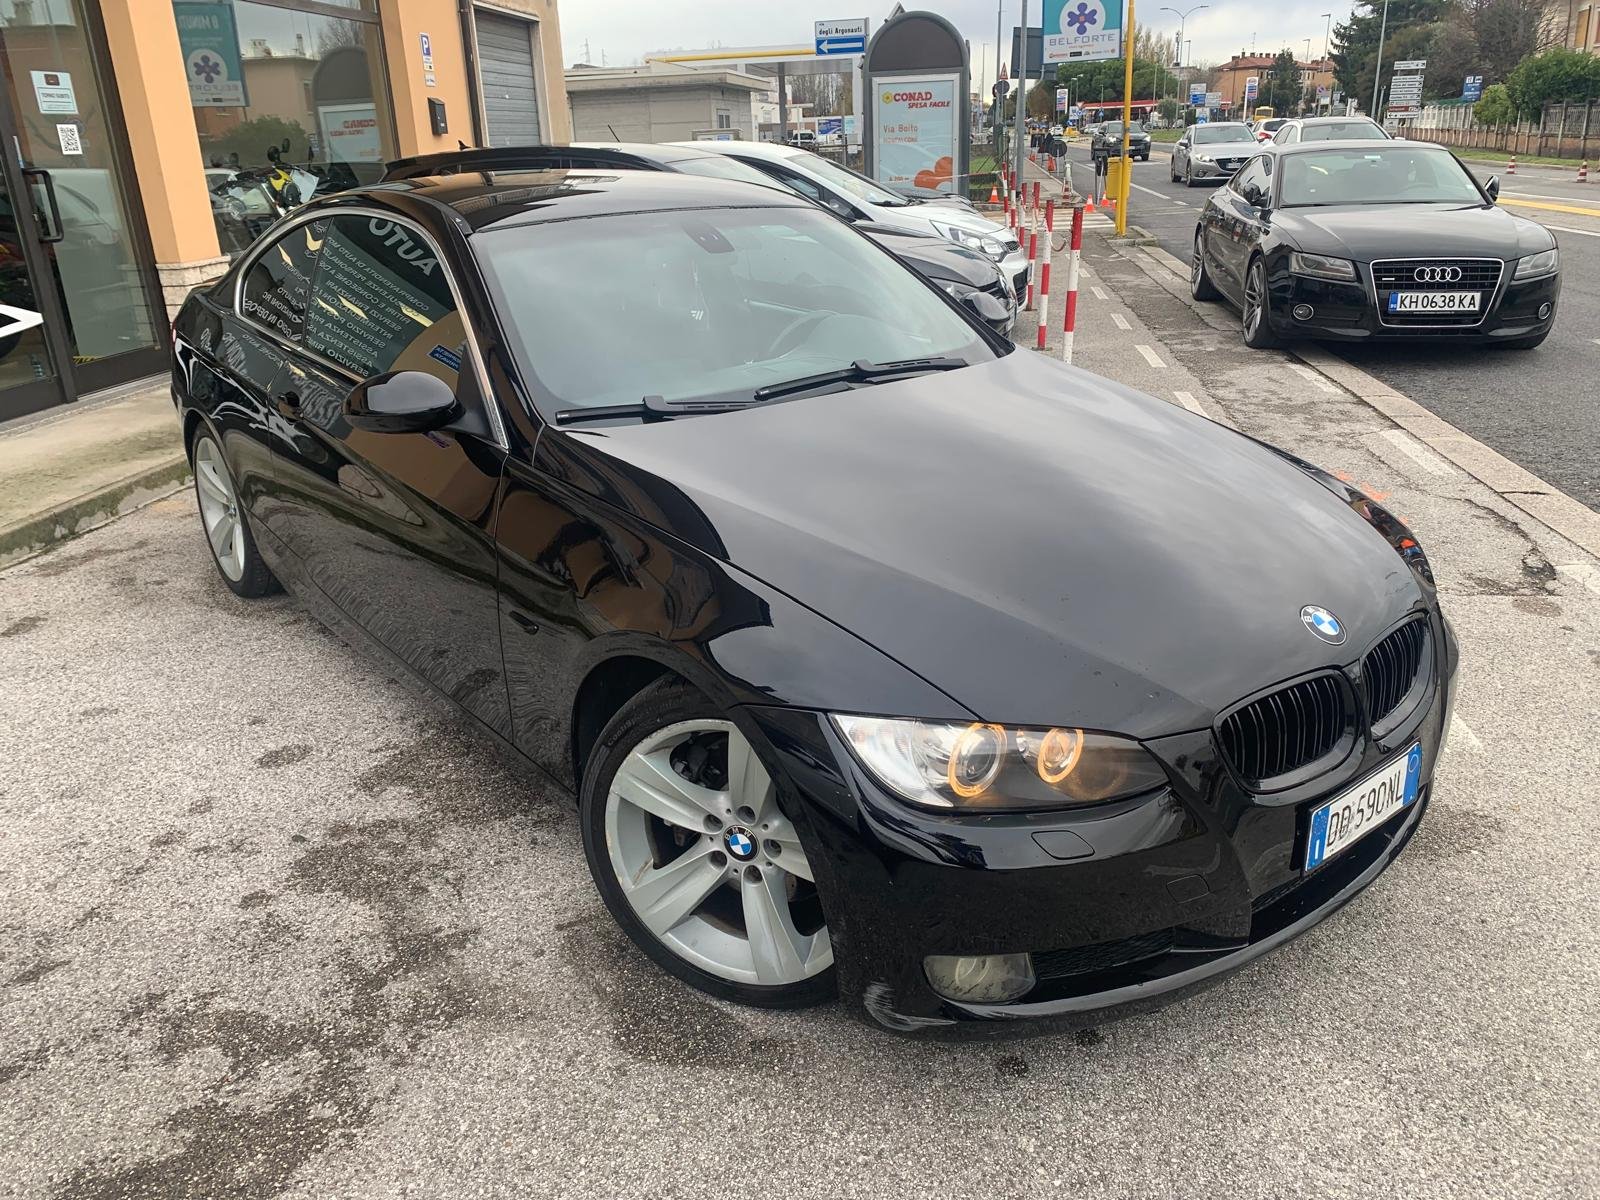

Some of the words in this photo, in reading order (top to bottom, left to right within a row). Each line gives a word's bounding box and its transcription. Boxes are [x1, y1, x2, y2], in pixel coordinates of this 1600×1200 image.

[818, 28, 832, 36] degli
[834, 26, 862, 34] Argonauti
[1049, 34, 1115, 46] BELFORTE
[893, 92, 932, 102] CONAD
[928, 100, 951, 108] FACILE
[884, 125, 894, 133] Via
[725, 827, 751, 840] BMW
